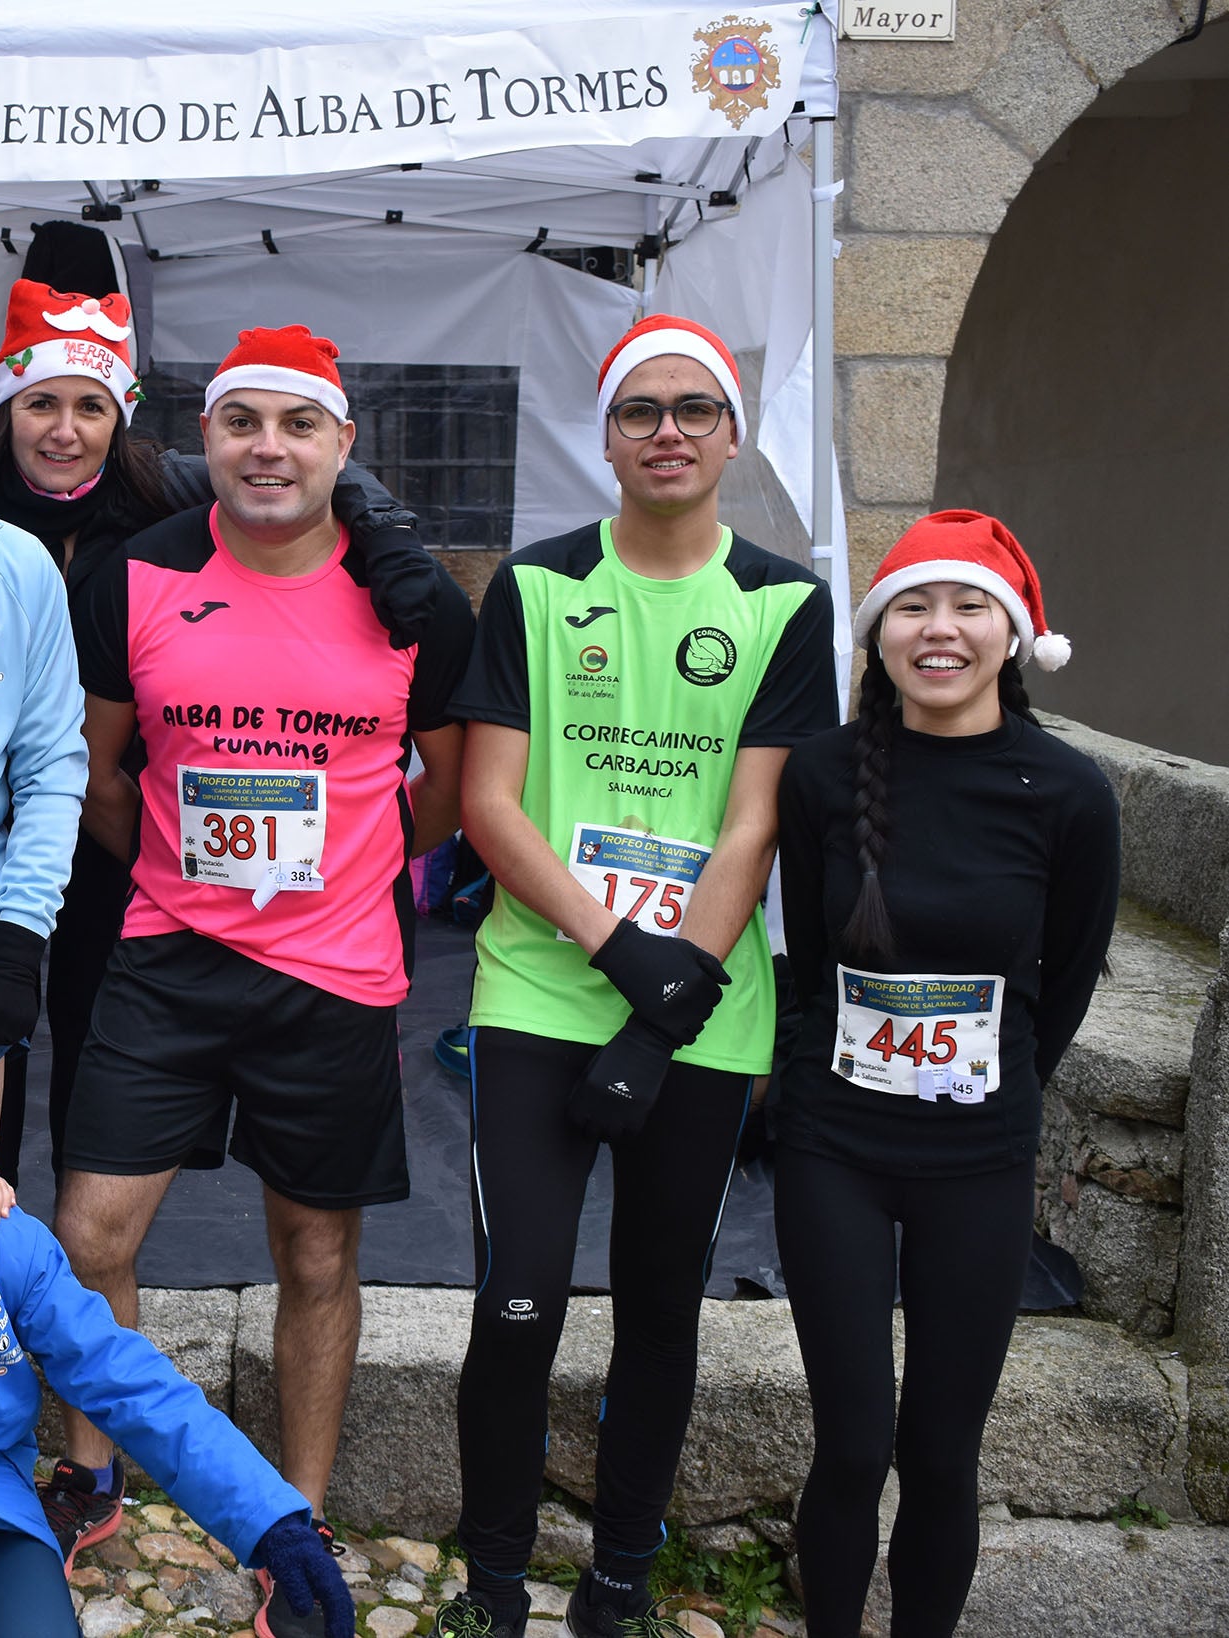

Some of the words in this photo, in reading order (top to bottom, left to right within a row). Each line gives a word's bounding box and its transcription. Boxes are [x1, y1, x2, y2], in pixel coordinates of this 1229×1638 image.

[852, 6, 944, 34] Mayor
[177, 101, 240, 143] DE
[248, 82, 381, 140] ALBA
[393, 83, 456, 127] DE
[464, 64, 669, 121] TORMES
[63, 340, 114, 370] MERRY
[65, 353, 112, 379] X-MAS
[565, 673, 619, 683] CARBAJOSA
[163, 704, 221, 729] ALBA
[233, 706, 265, 729] DE
[276, 708, 380, 737] TORMES
[213, 735, 329, 765] running
[563, 724, 725, 754] CORRECAMINOS
[586, 753, 699, 779] CARBAJOSA
[198, 776, 235, 786] TROFEO
[238, 778, 252, 786] DE
[254, 778, 300, 788] NAVIDAD
[608, 782, 673, 798] SALAMANCA
[203, 813, 277, 861] 381
[600, 834, 643, 848] TROFEO
[644, 842, 659, 852] DE
[660, 845, 701, 861] NAVIDAD
[204, 870, 229, 879] Salamanca
[655, 862, 694, 875] SALAMANCA
[603, 873, 685, 929] 175
[862, 980, 905, 993] TROFEO
[908, 984, 923, 993] DE
[926, 983, 976, 992] NAVIDAD
[922, 1001, 967, 1009] SALAMANCA
[866, 1017, 957, 1067] 445
[861, 1073, 892, 1085] Salamanca
